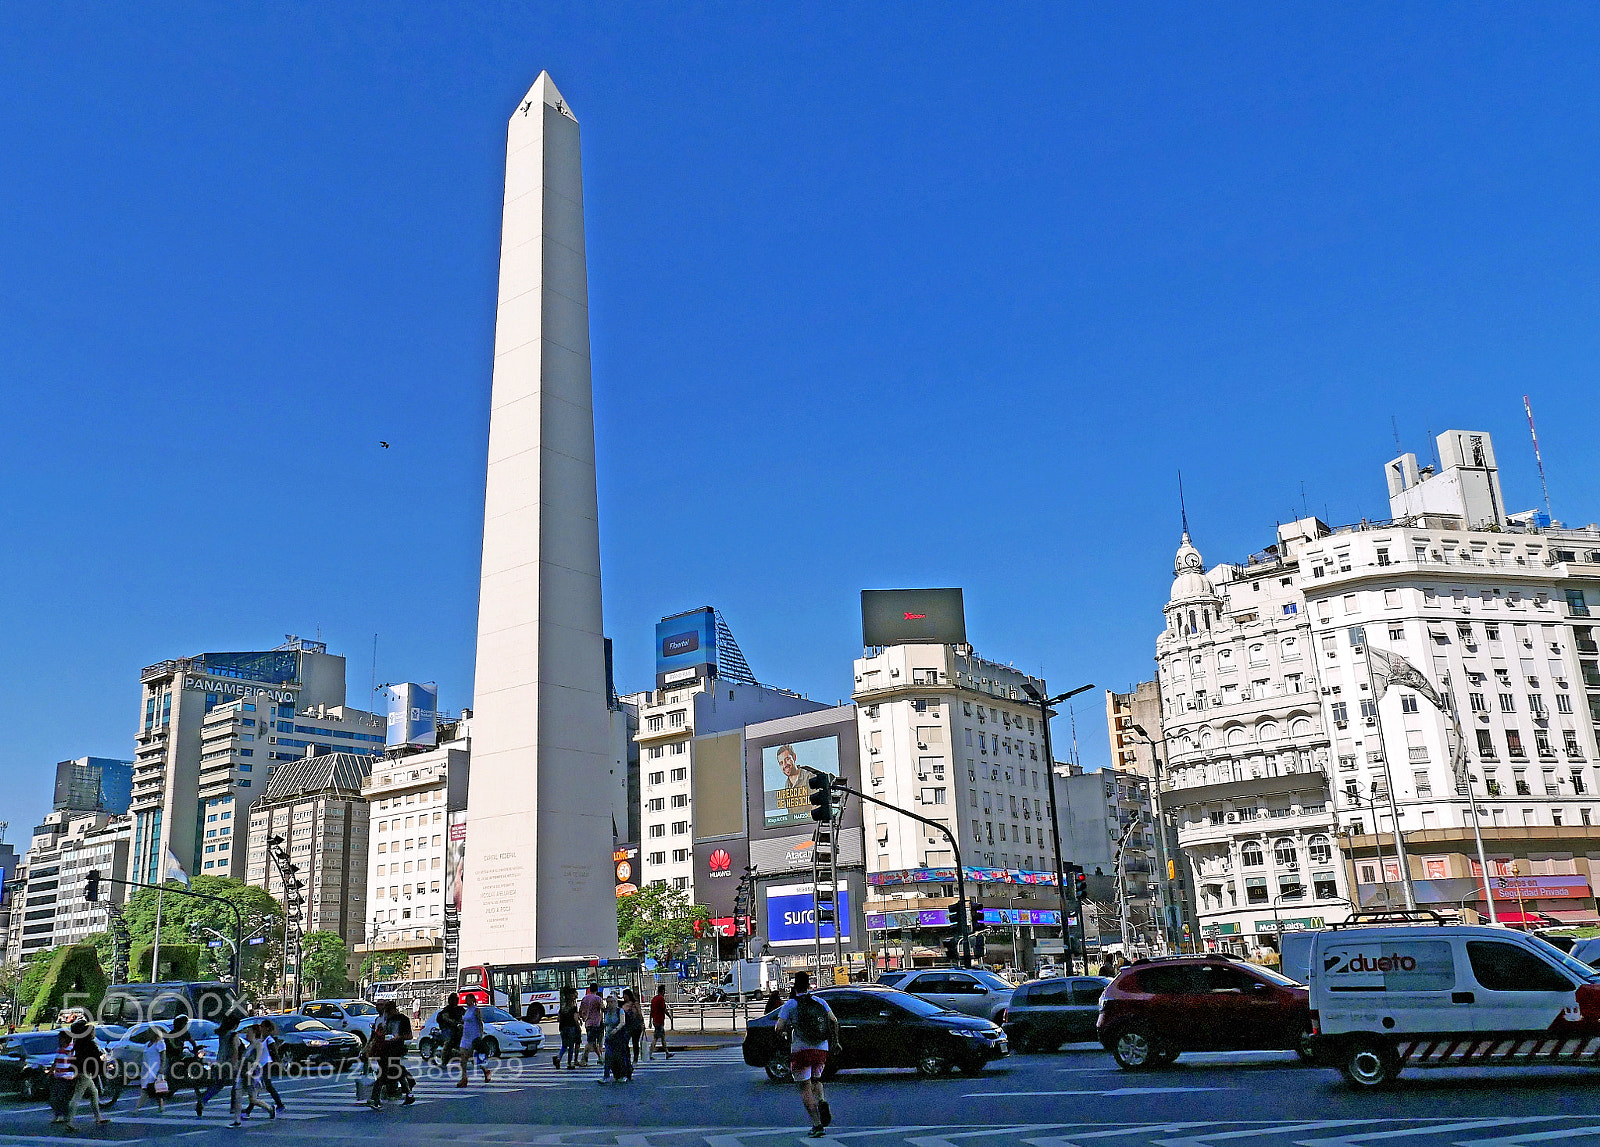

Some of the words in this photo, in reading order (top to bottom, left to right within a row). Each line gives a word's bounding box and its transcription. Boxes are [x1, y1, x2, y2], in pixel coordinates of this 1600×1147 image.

[709, 870, 732, 878] HUAWEI
[1540, 887, 1569, 896] Privada
[1259, 921, 1305, 932] McDnald's
[1349, 952, 1417, 972] dueto
